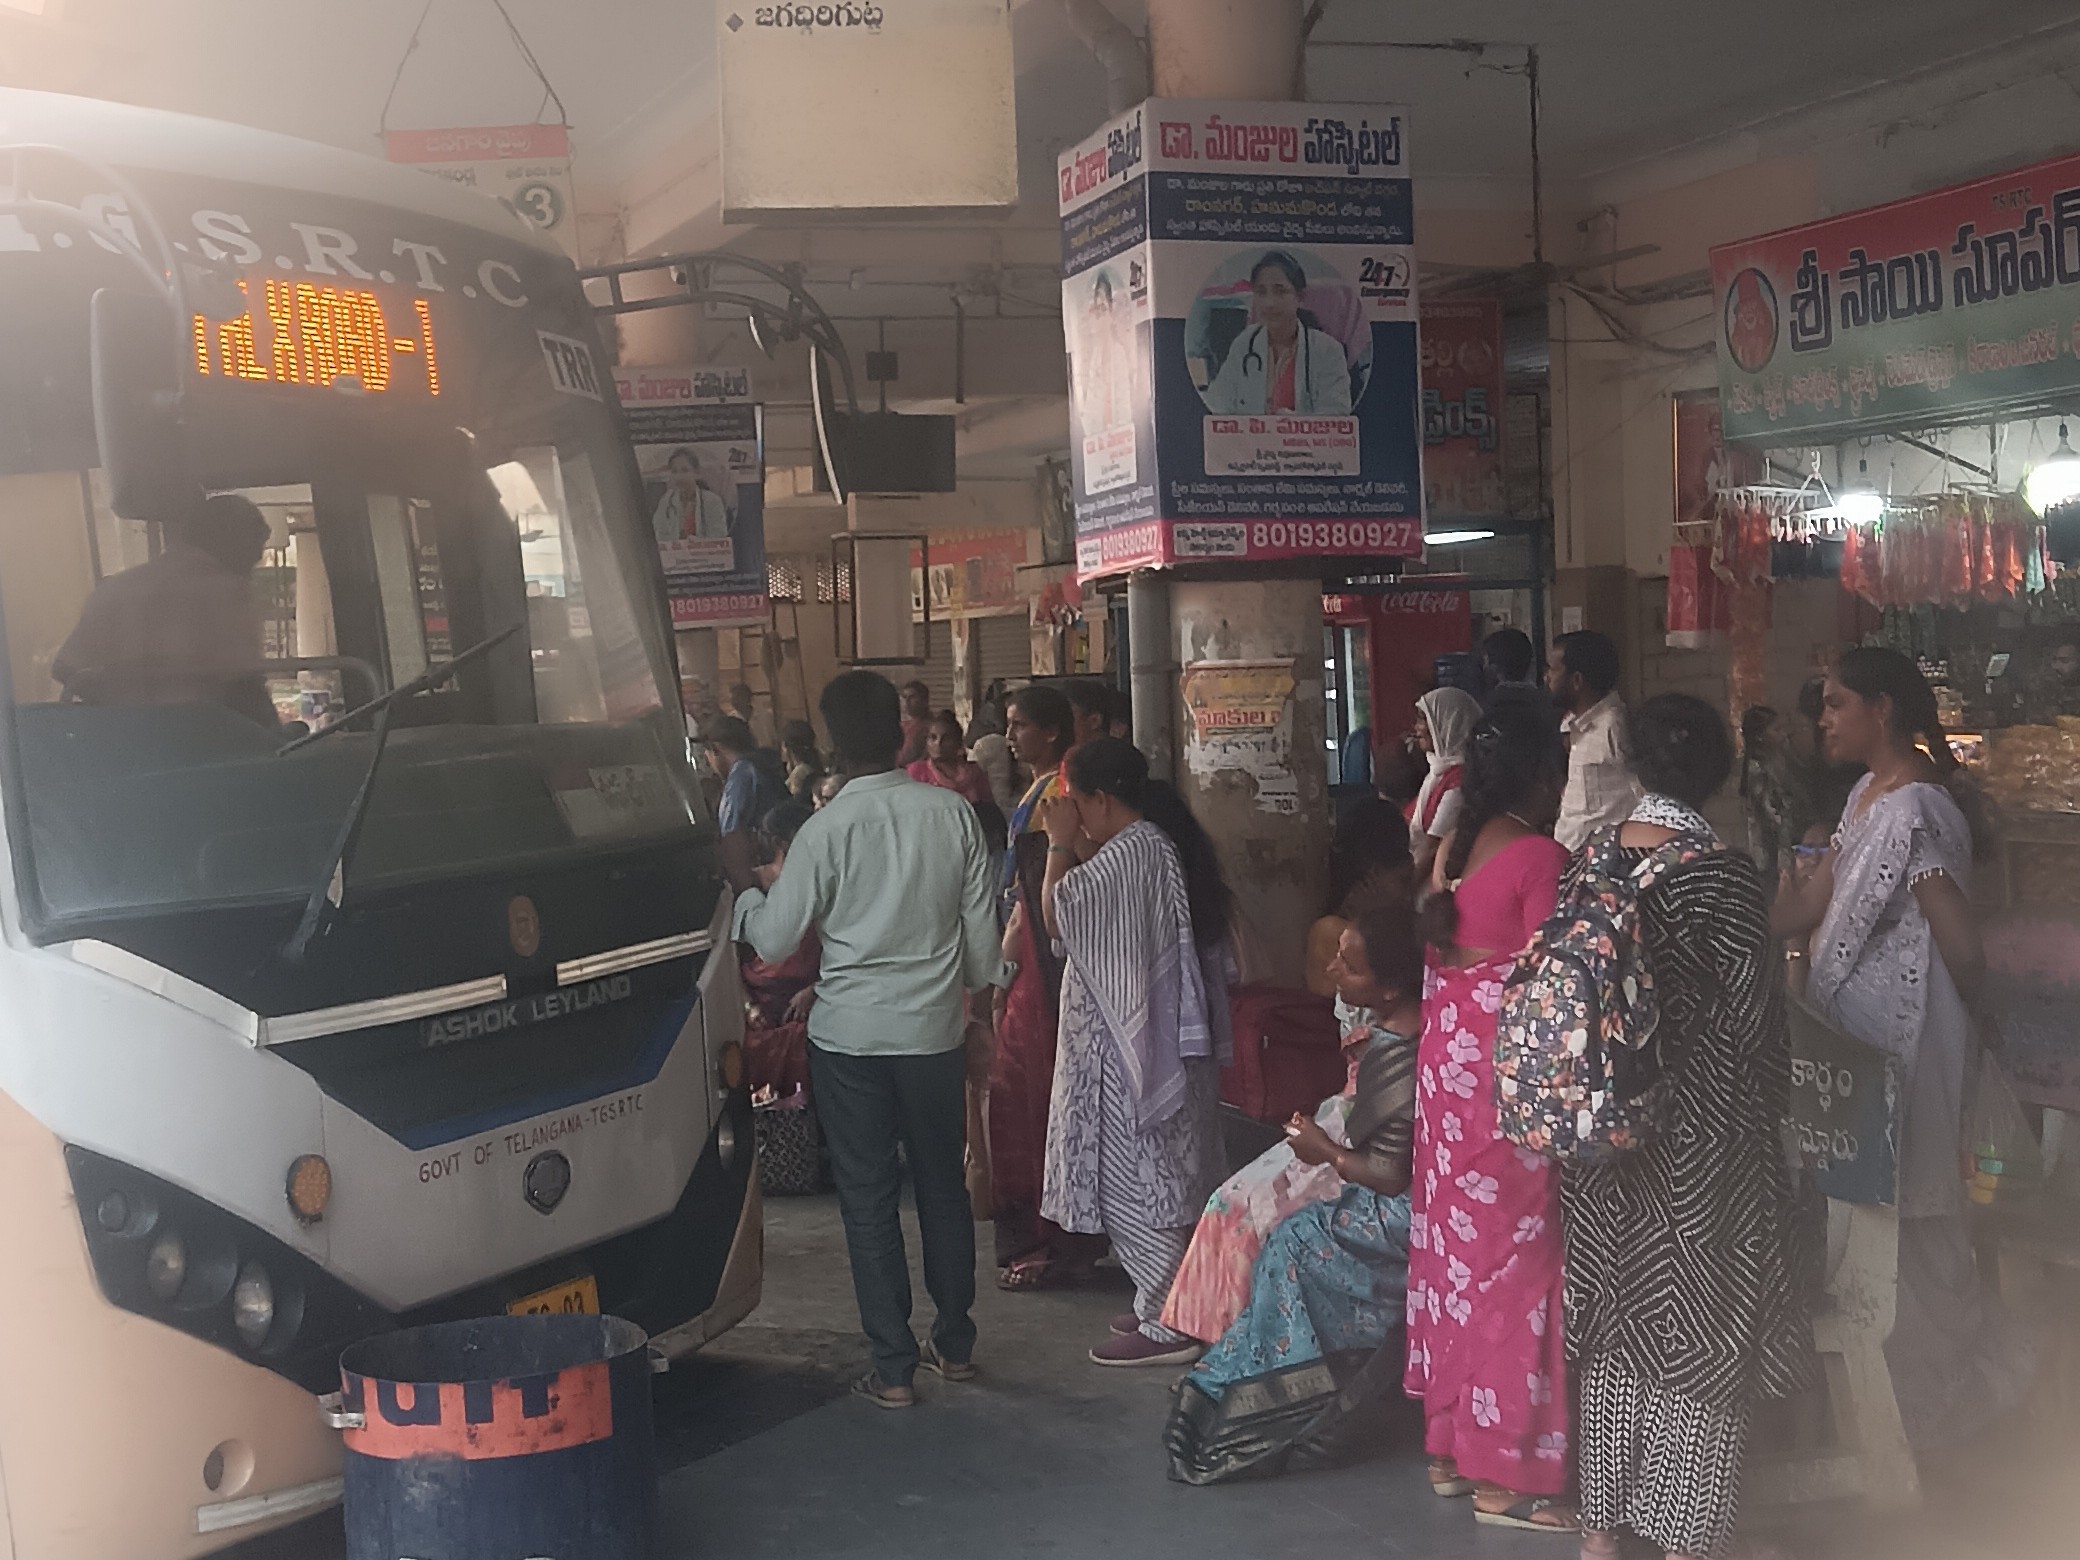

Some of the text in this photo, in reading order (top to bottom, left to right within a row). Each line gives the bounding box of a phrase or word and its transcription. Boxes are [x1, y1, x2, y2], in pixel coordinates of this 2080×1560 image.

[524, 187, 555, 229] 3
[1790, 248, 1834, 353] శ్రీ
[1839, 248, 1943, 331] సాయి
[547, 335, 598, 402] TRR
[1253, 522, 1412, 548] 8019380927
[677, 595, 764, 614] 8019380927
[427, 975, 632, 1047] ASHOK LEYLAND
[419, 1152, 461, 1184] GOVT
[473, 1142, 494, 1166] OF
